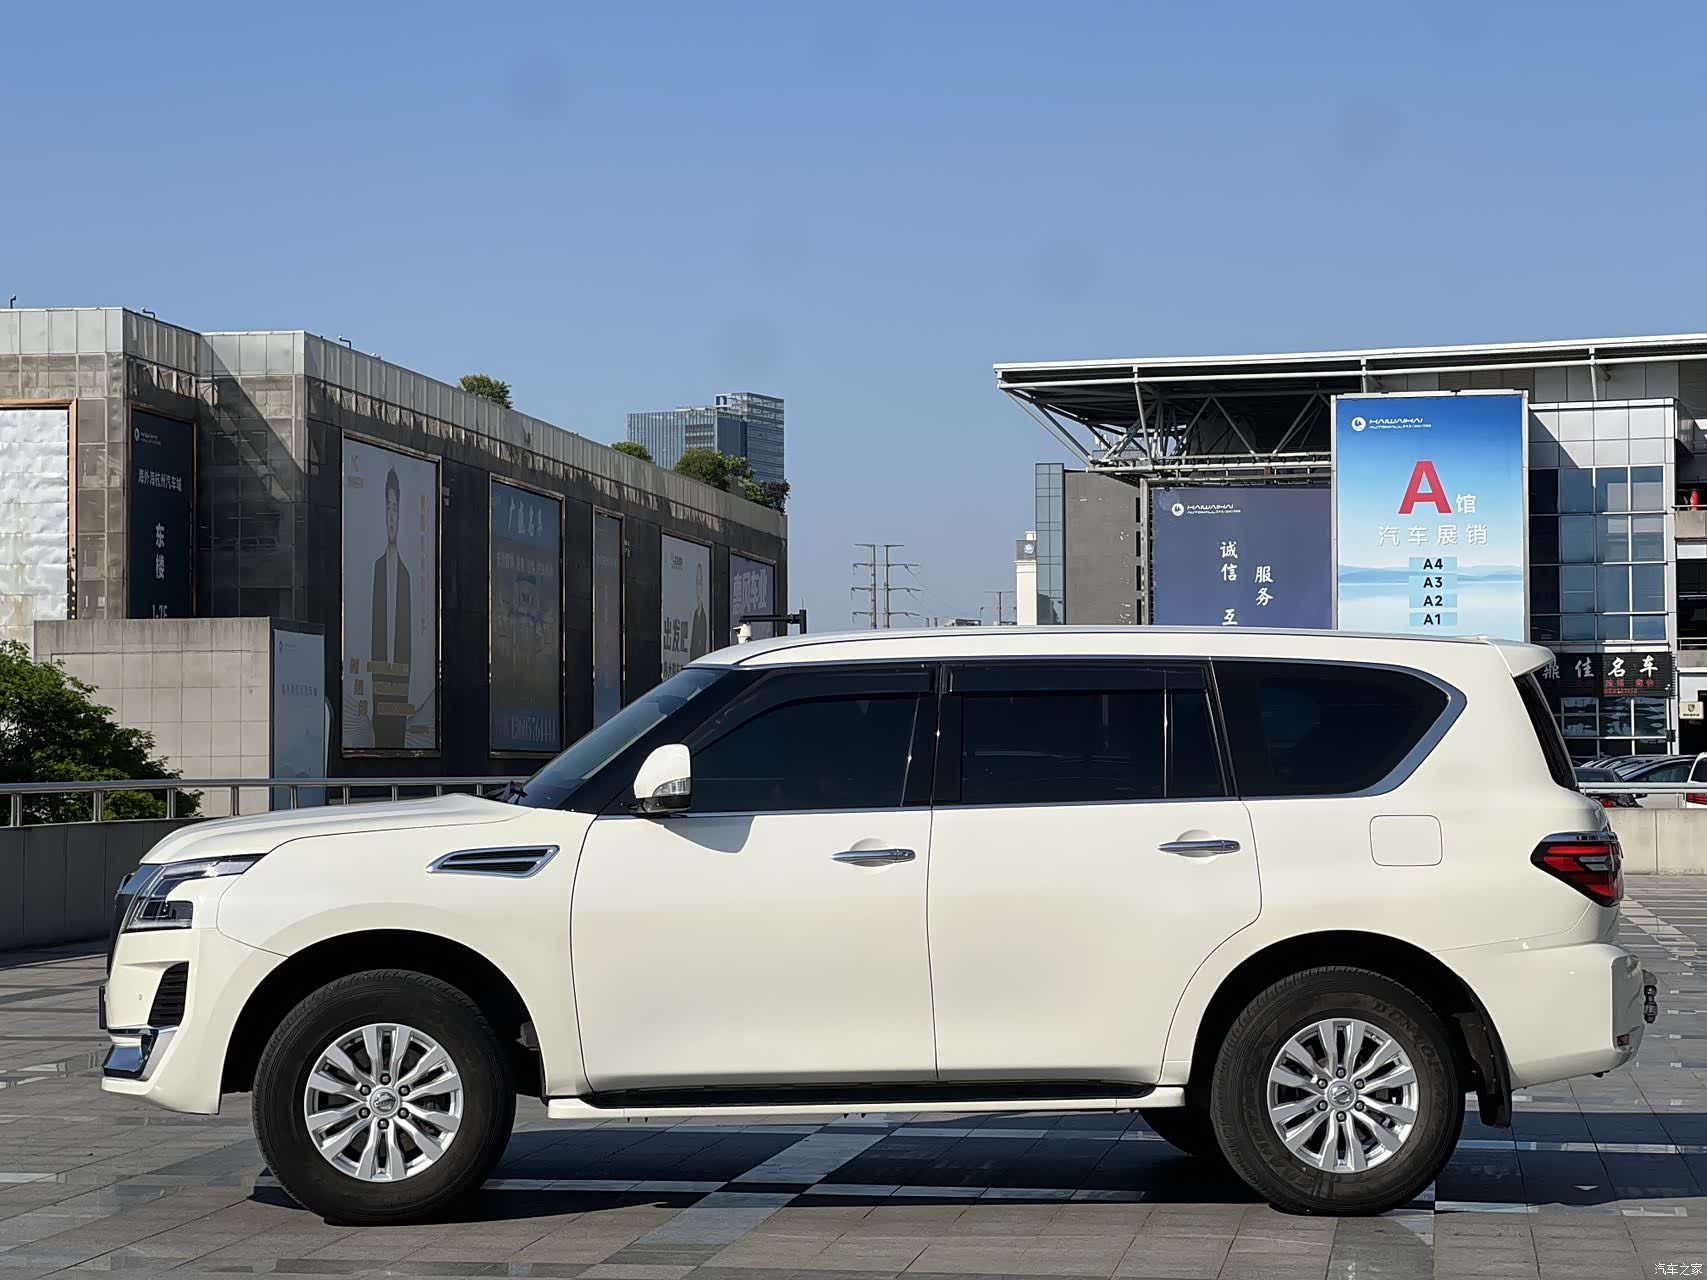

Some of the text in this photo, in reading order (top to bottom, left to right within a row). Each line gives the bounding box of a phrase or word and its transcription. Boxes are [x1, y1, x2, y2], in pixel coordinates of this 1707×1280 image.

[1378, 524, 1488, 546] 汽车展销
[1423, 558, 1443, 570] A4
[1254, 565, 1274, 606] 服务
[1423, 577, 1443, 588] A3
[1423, 595, 1443, 607] A2
[1423, 613, 1441, 625] A1
